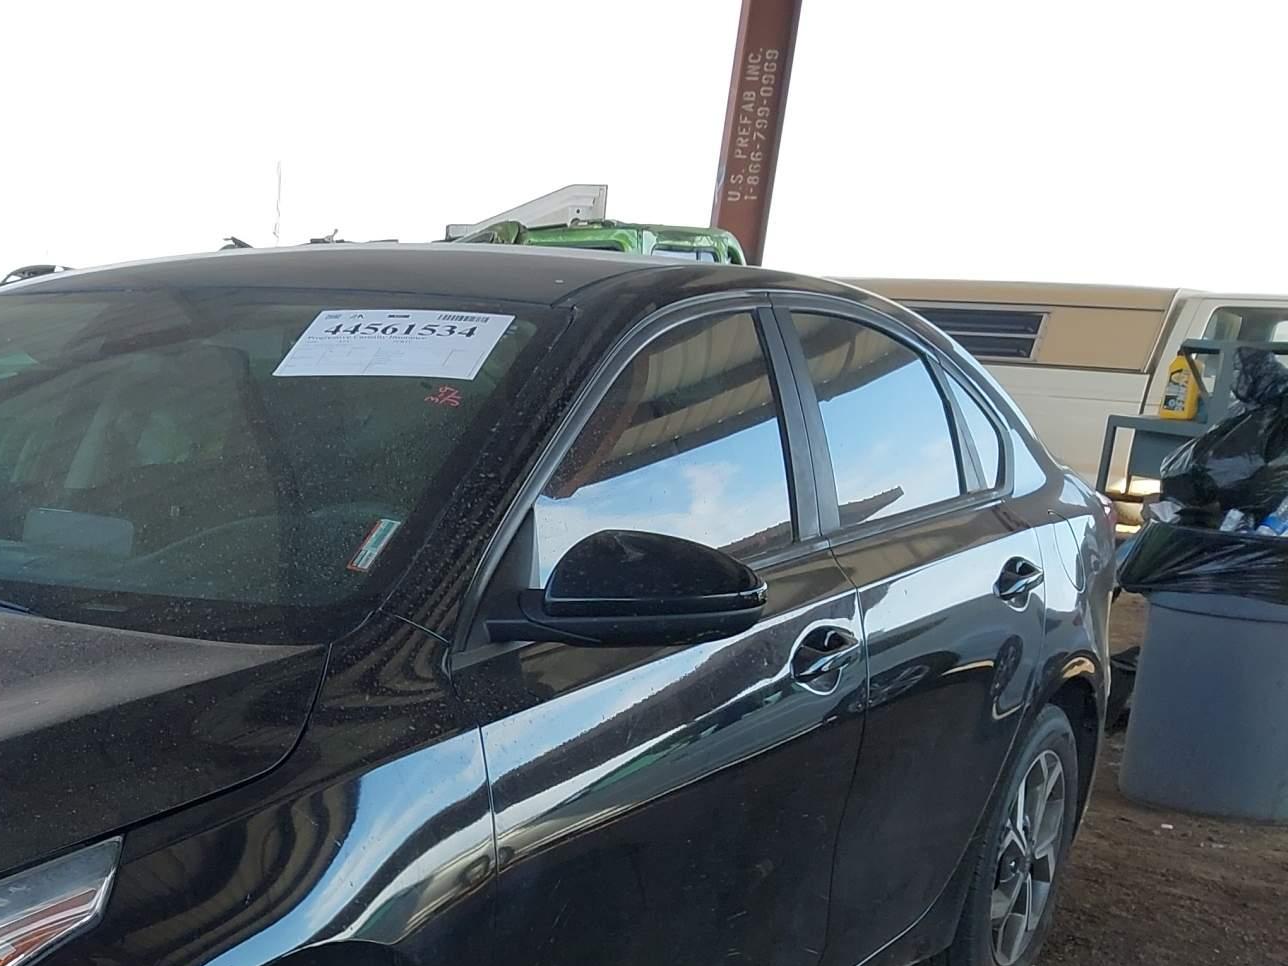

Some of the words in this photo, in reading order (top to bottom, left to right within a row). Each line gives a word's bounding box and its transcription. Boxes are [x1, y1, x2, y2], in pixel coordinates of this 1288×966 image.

[746, 47, 764, 82] INC.
[735, 91, 756, 159] PREFAB
[744, 49, 779, 201] 1-866-799-0969
[727, 168, 744, 202] U.S.
[324, 323, 478, 338] 44561534
